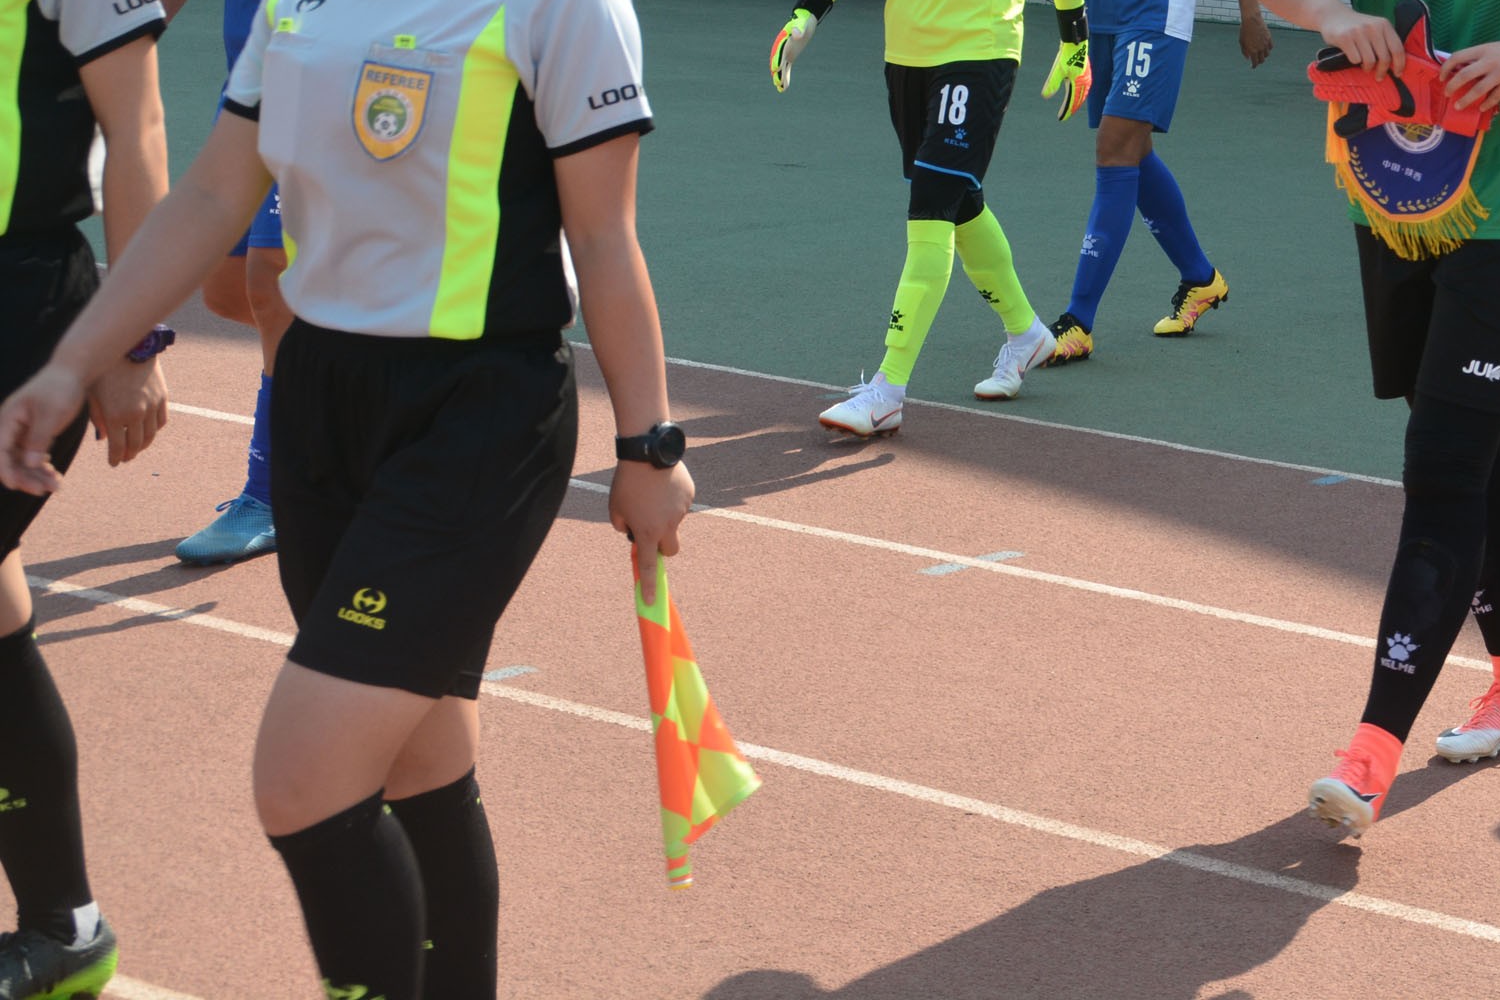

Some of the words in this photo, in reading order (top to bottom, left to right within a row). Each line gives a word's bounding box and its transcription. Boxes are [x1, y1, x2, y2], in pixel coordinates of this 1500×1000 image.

[1125, 41, 1153, 78] 15
[365, 69, 426, 91] REFEREE
[588, 84, 642, 110] LOO
[938, 84, 969, 126] 18
[338, 606, 386, 630] LOOKS
